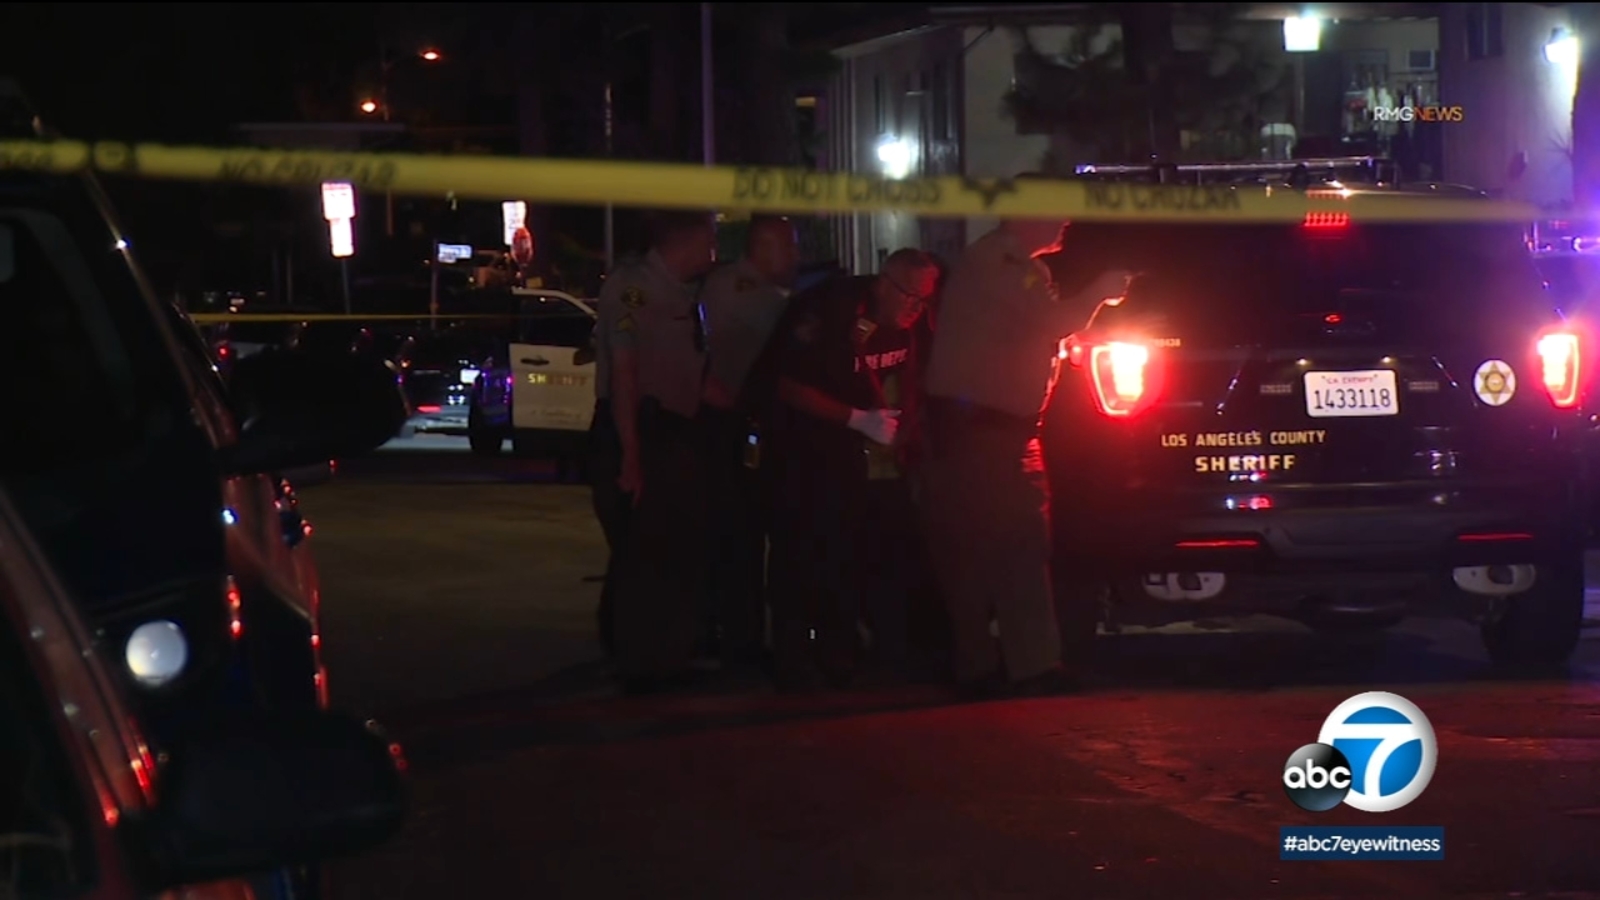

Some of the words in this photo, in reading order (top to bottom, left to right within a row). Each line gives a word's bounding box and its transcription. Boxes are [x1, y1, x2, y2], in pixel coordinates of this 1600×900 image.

[734, 168, 771, 199] DO
[780, 171, 829, 201] NOT
[848, 175, 941, 204] CROSS
[1084, 182, 1127, 210] NO
[1132, 182, 1241, 211] CRUZAR
[1314, 388, 1391, 409] 1433118
[1161, 434, 1187, 447] LOS
[1195, 431, 1262, 446] ANGELES
[1270, 430, 1326, 445] COUNTY
[1195, 455, 1295, 472] SHERIFF
